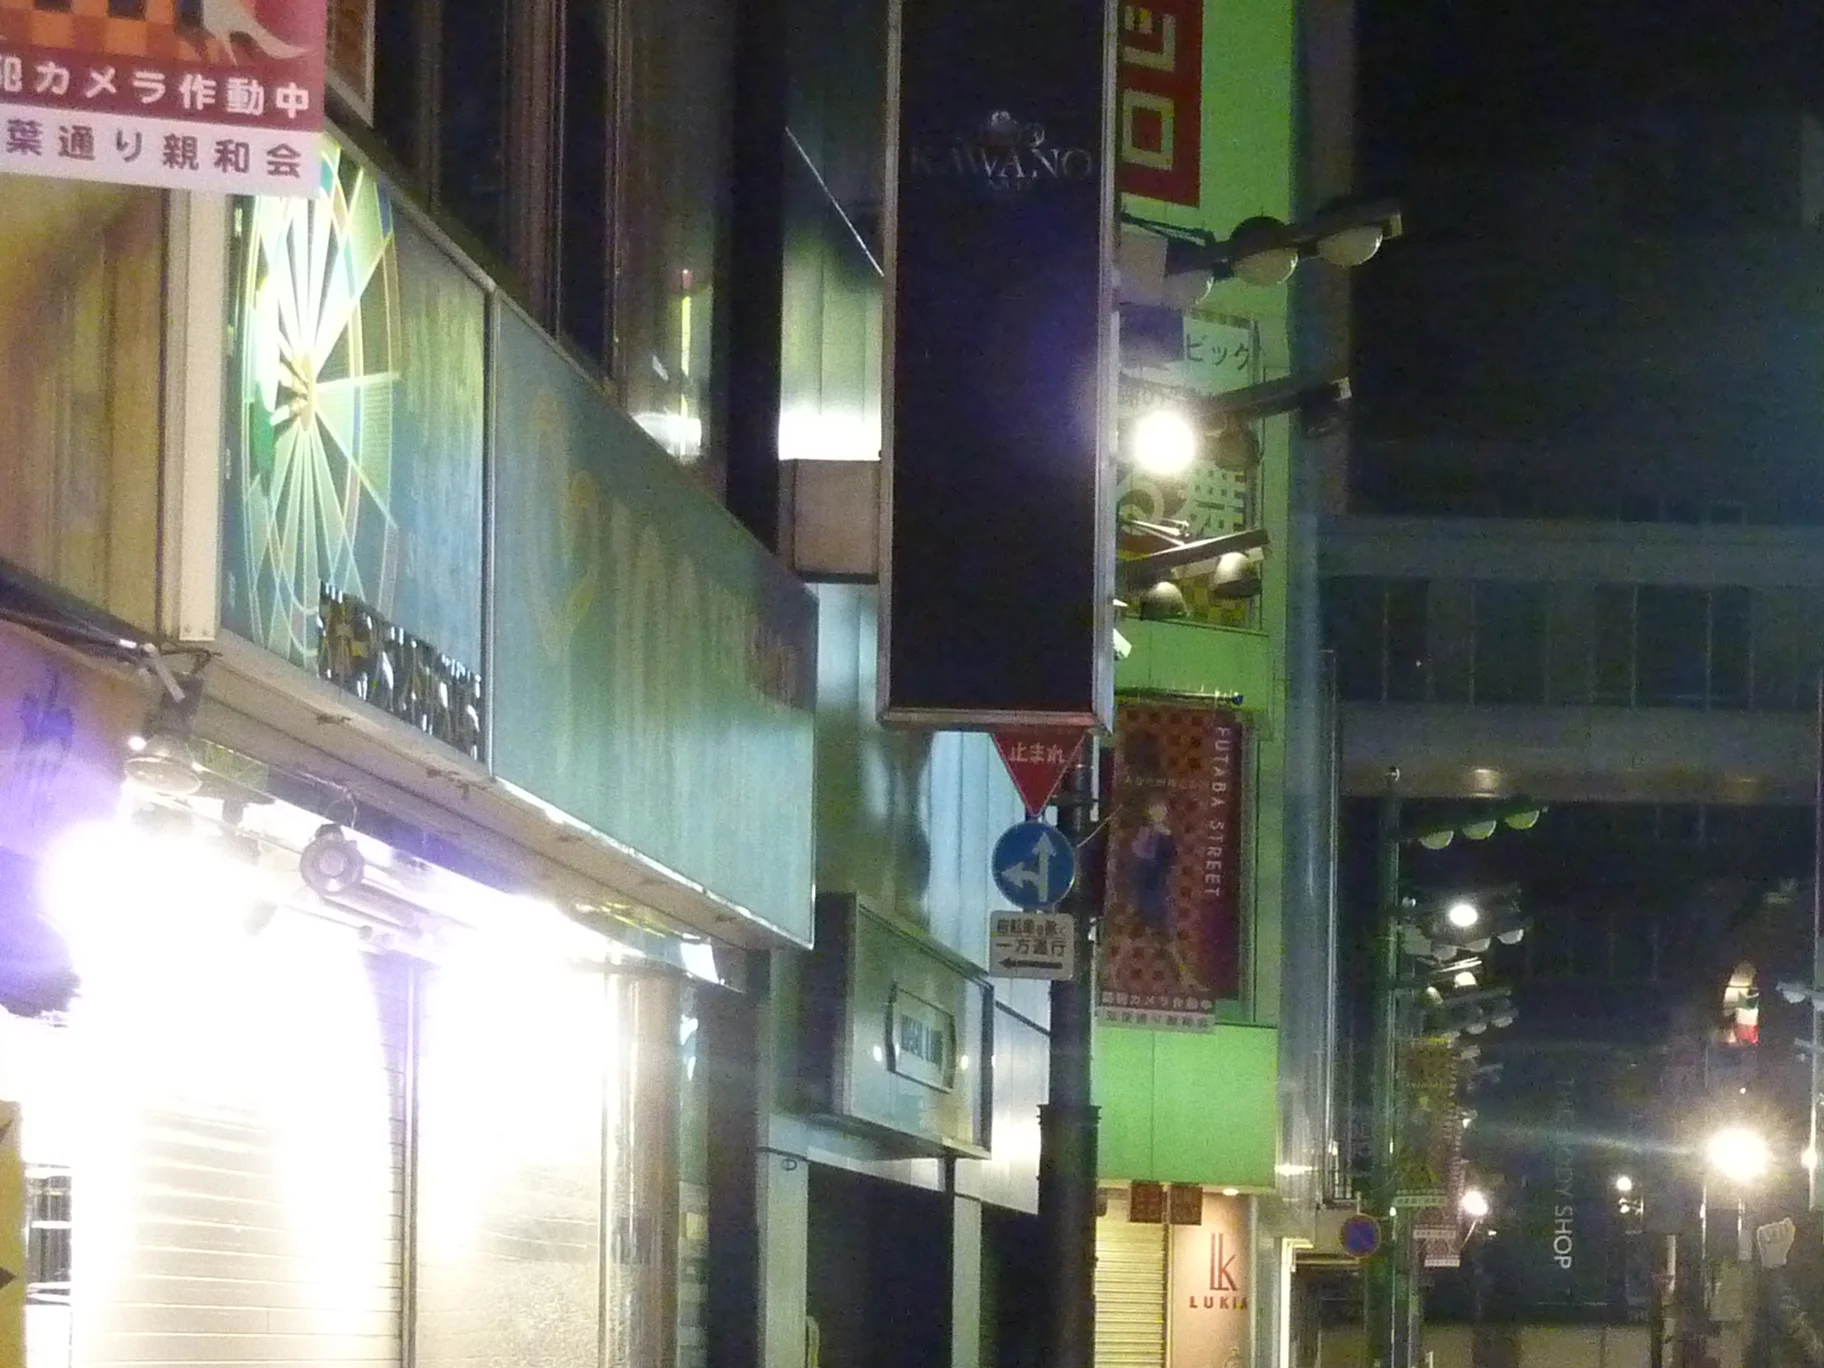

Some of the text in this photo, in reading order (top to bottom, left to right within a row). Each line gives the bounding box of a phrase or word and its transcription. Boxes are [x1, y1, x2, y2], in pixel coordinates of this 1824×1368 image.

[5, 119, 302, 178] 葉通り親和会
[1008, 742, 1065, 765] 止まれ
[1204, 726, 1232, 897] FUTABA STREET
[1553, 1204, 1574, 1270] SHOP
[1189, 1295, 1249, 1310] LUKIA
